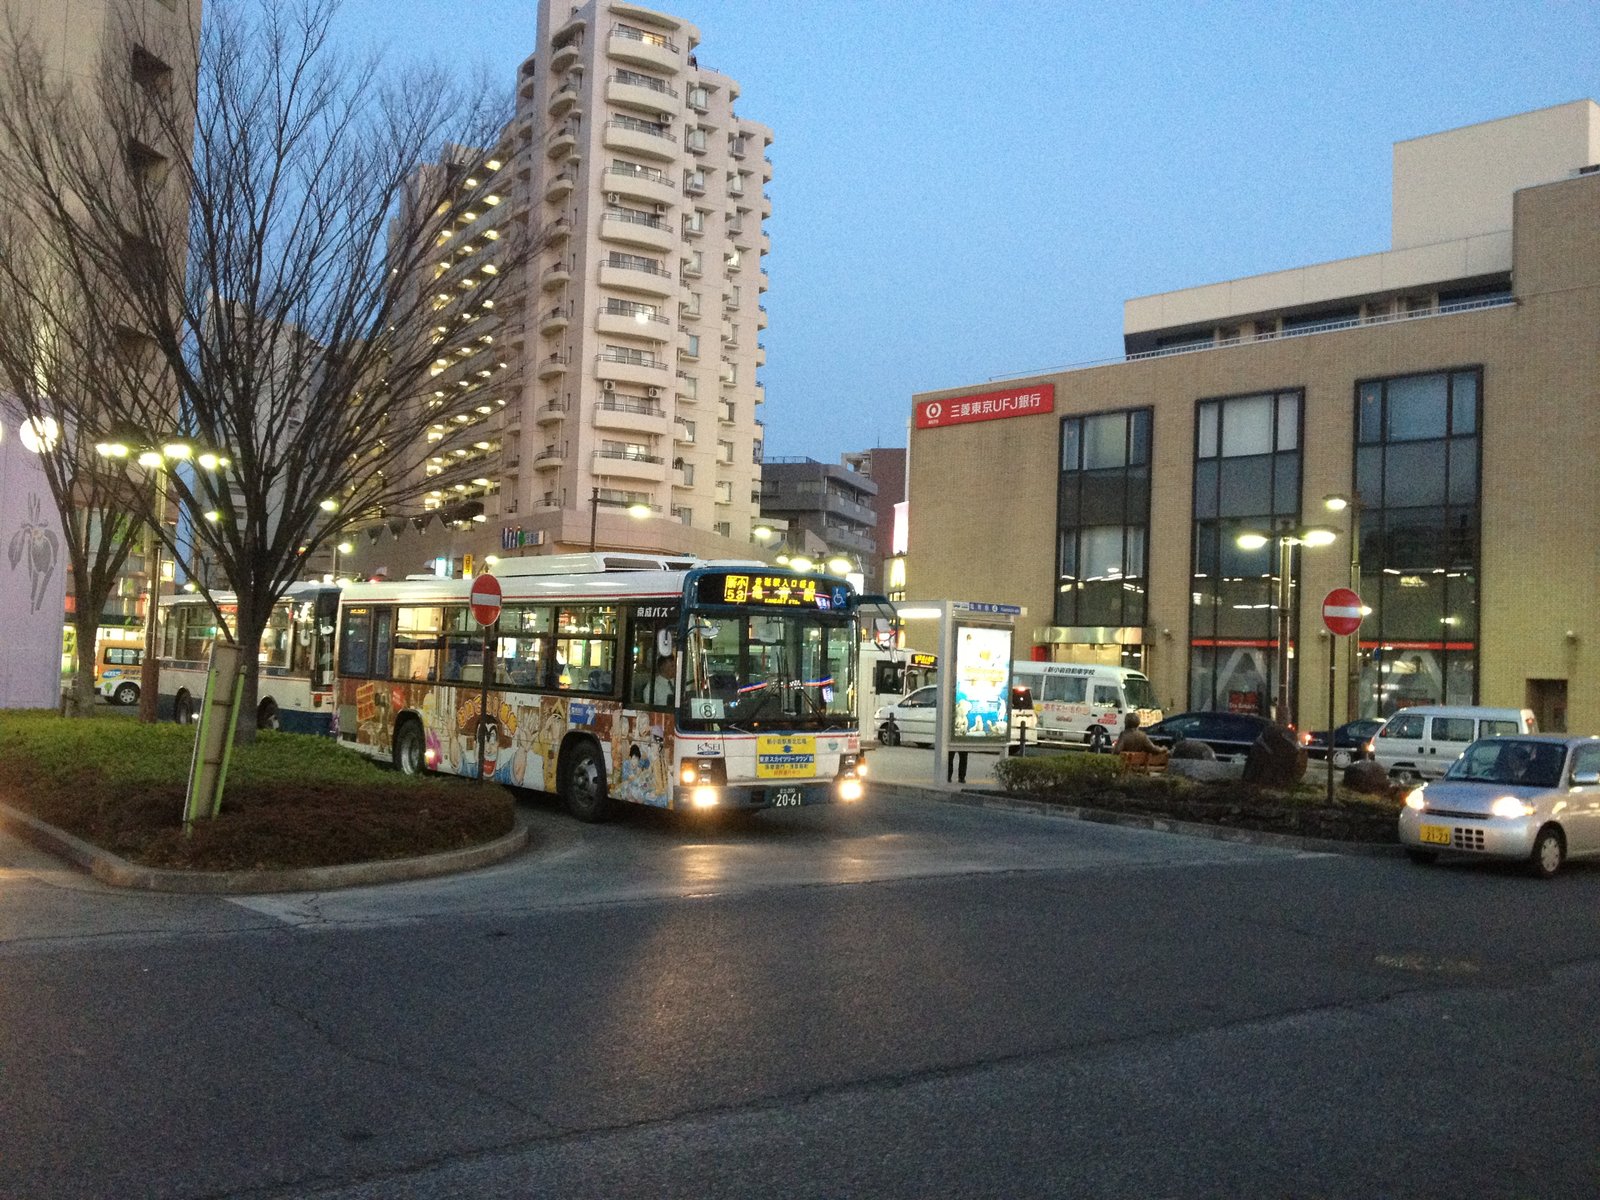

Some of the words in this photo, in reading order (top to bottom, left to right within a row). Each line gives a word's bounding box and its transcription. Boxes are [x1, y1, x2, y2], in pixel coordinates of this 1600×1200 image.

[951, 393, 1041, 418] 三菱東京UFJ銀行
[637, 606, 669, 618] 京成バス
